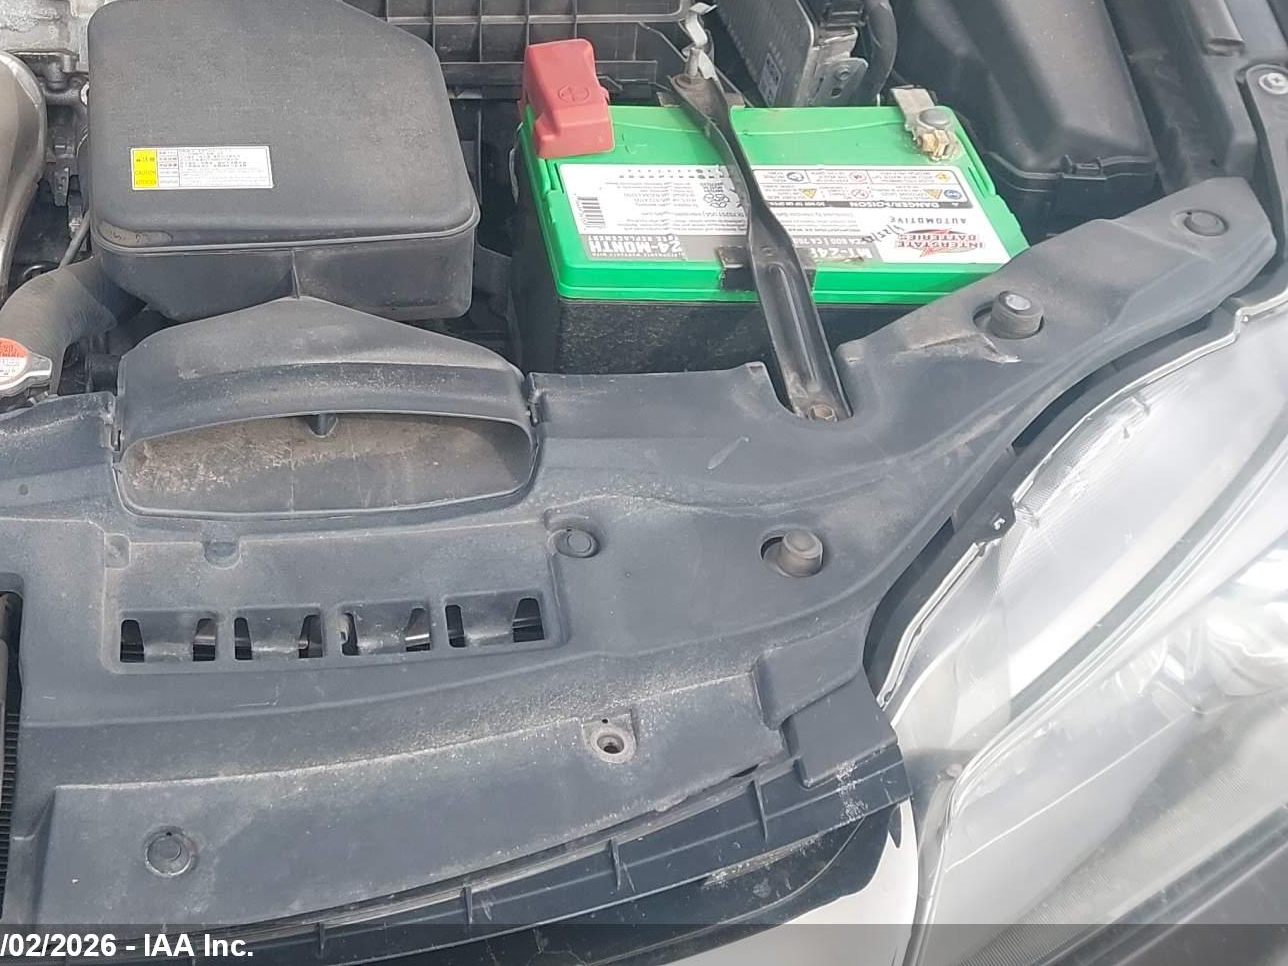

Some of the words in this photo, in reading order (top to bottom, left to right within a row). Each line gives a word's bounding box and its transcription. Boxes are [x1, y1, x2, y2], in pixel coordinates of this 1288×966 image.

[898, 234, 977, 242] BATTERIES
[588, 240, 682, 253] 24-MONTH
[897, 241, 984, 249] INTERSTATE
